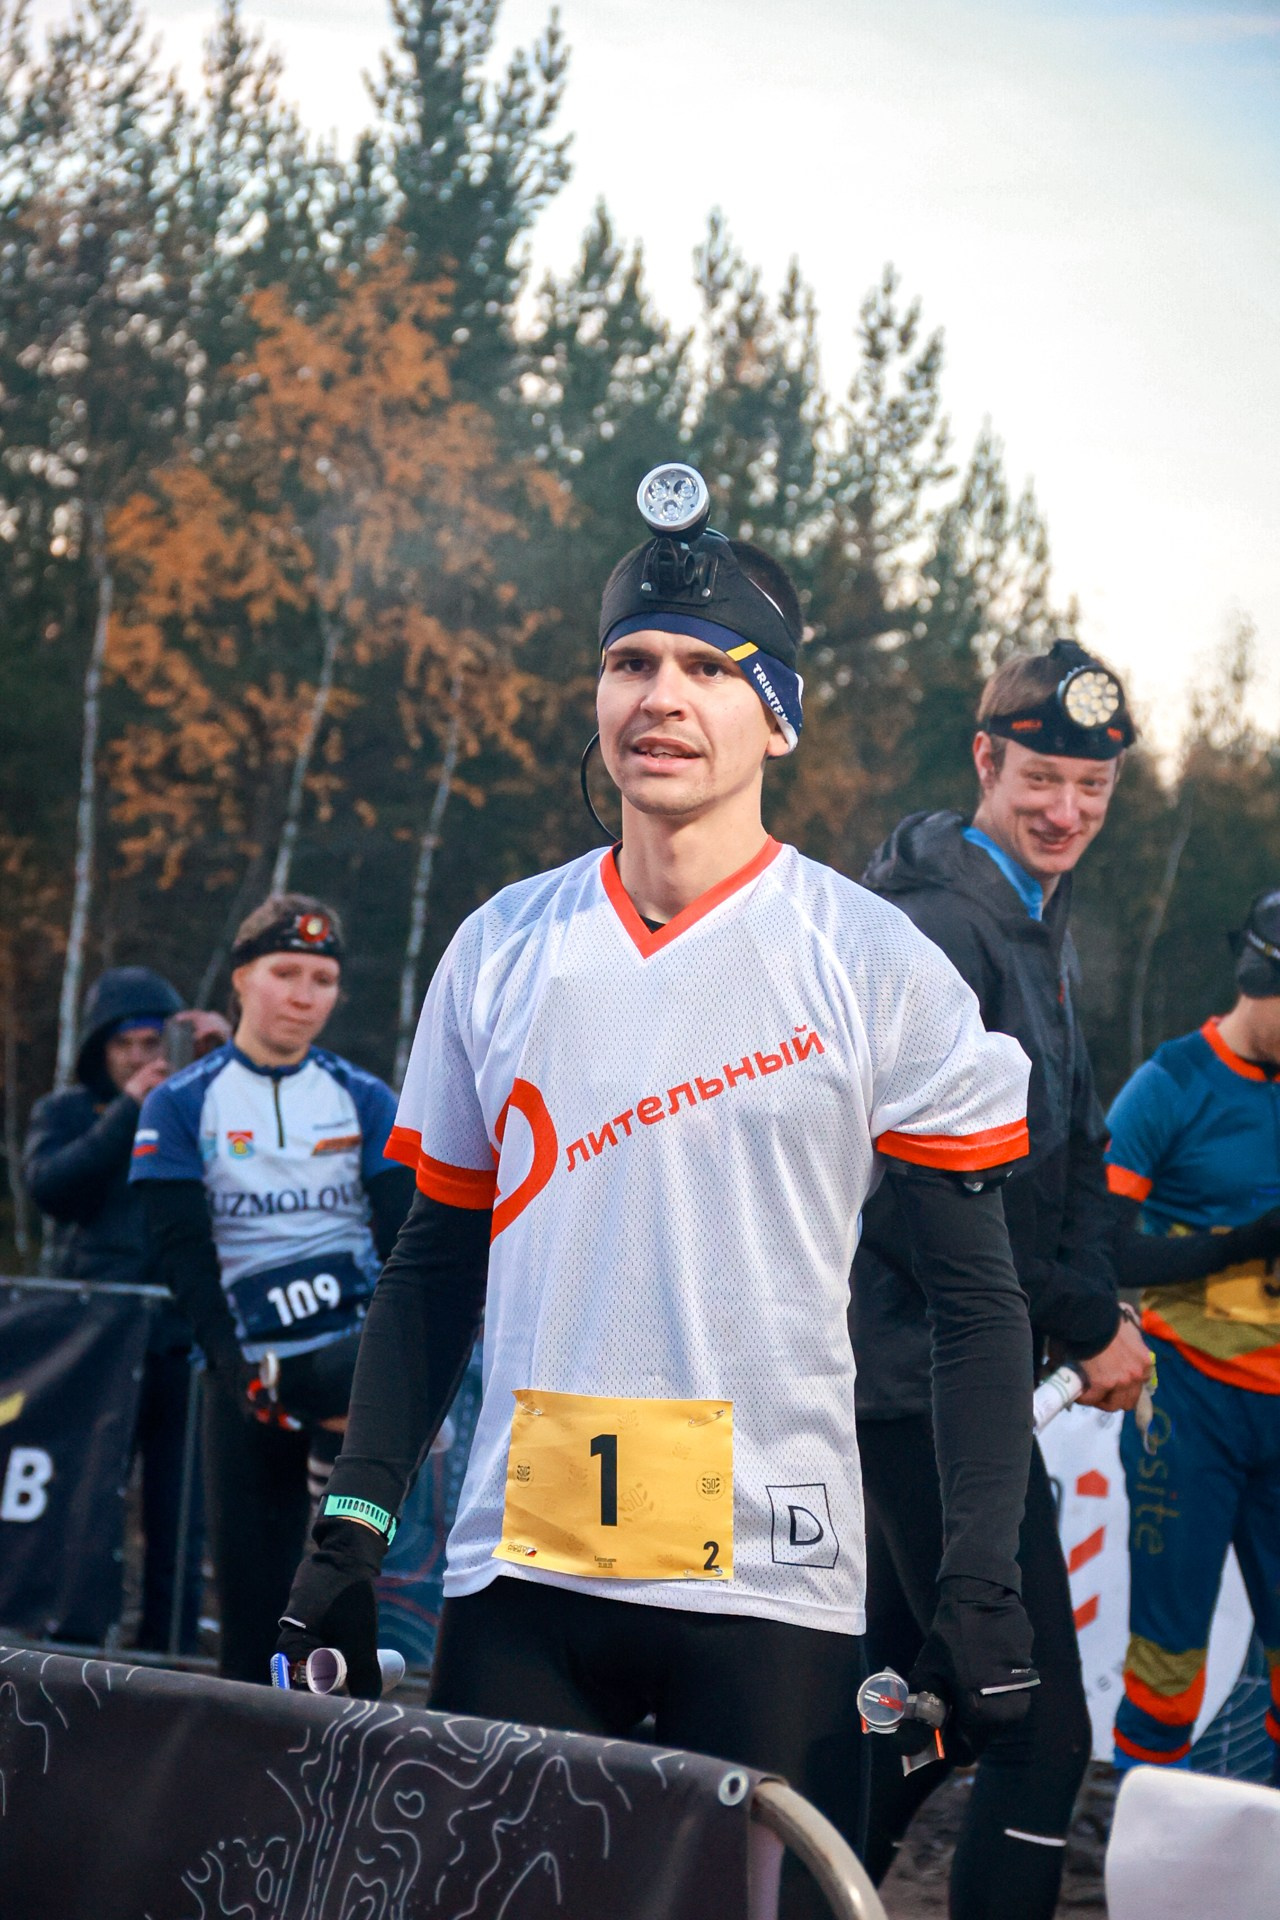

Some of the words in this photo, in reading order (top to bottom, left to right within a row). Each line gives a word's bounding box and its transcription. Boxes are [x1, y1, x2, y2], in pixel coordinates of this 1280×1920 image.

[267, 1272, 342, 1327] 109
[1, 1447, 53, 1522] B
[589, 1433, 618, 1527] 1
[706, 1478, 716, 1490] 50
[787, 1505, 824, 1546] D
[703, 1540, 720, 1571] 2
